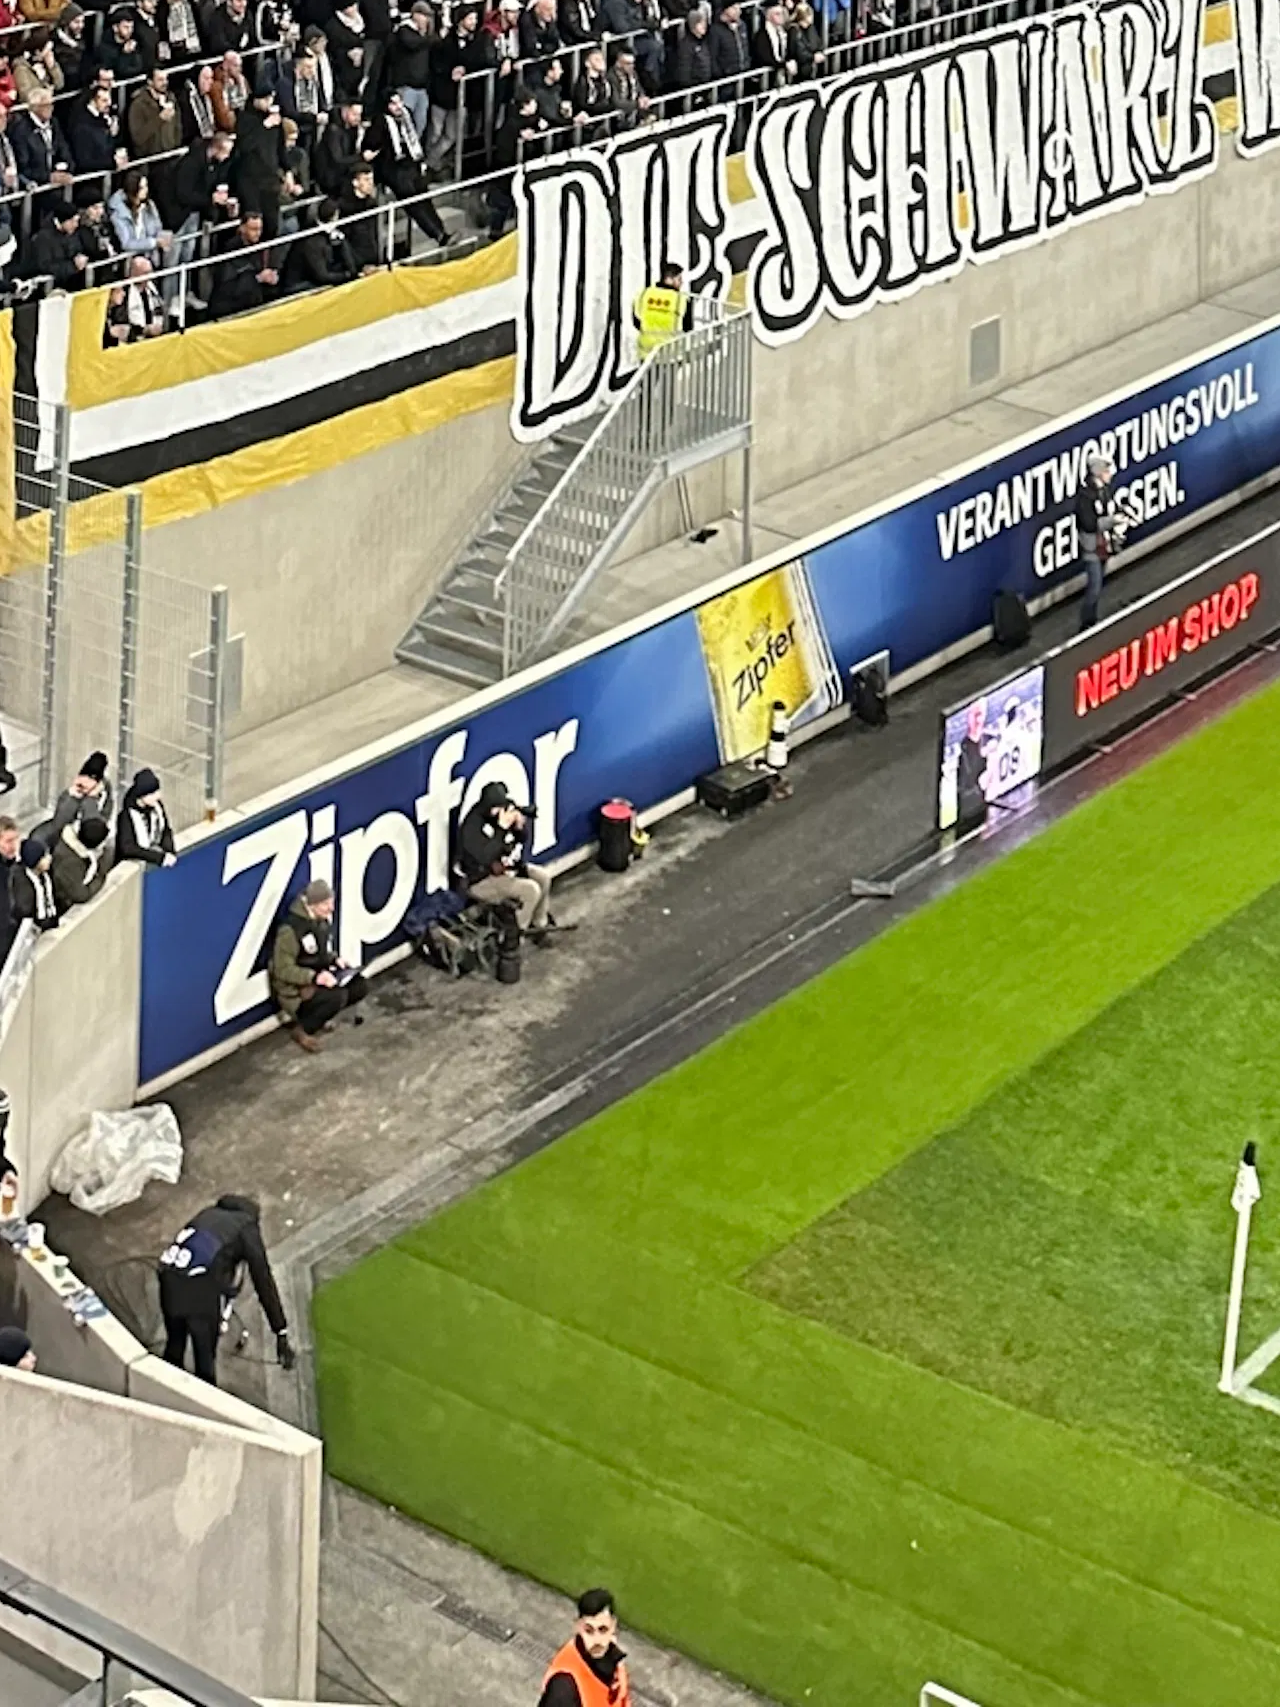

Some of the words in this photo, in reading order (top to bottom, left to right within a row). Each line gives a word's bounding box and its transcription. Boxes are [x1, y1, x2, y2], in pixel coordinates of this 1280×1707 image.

[731, 618, 796, 713] Zipfer
[1075, 637, 1141, 717] NEU
[1144, 615, 1180, 678] IM
[1183, 572, 1259, 654] SHOP
